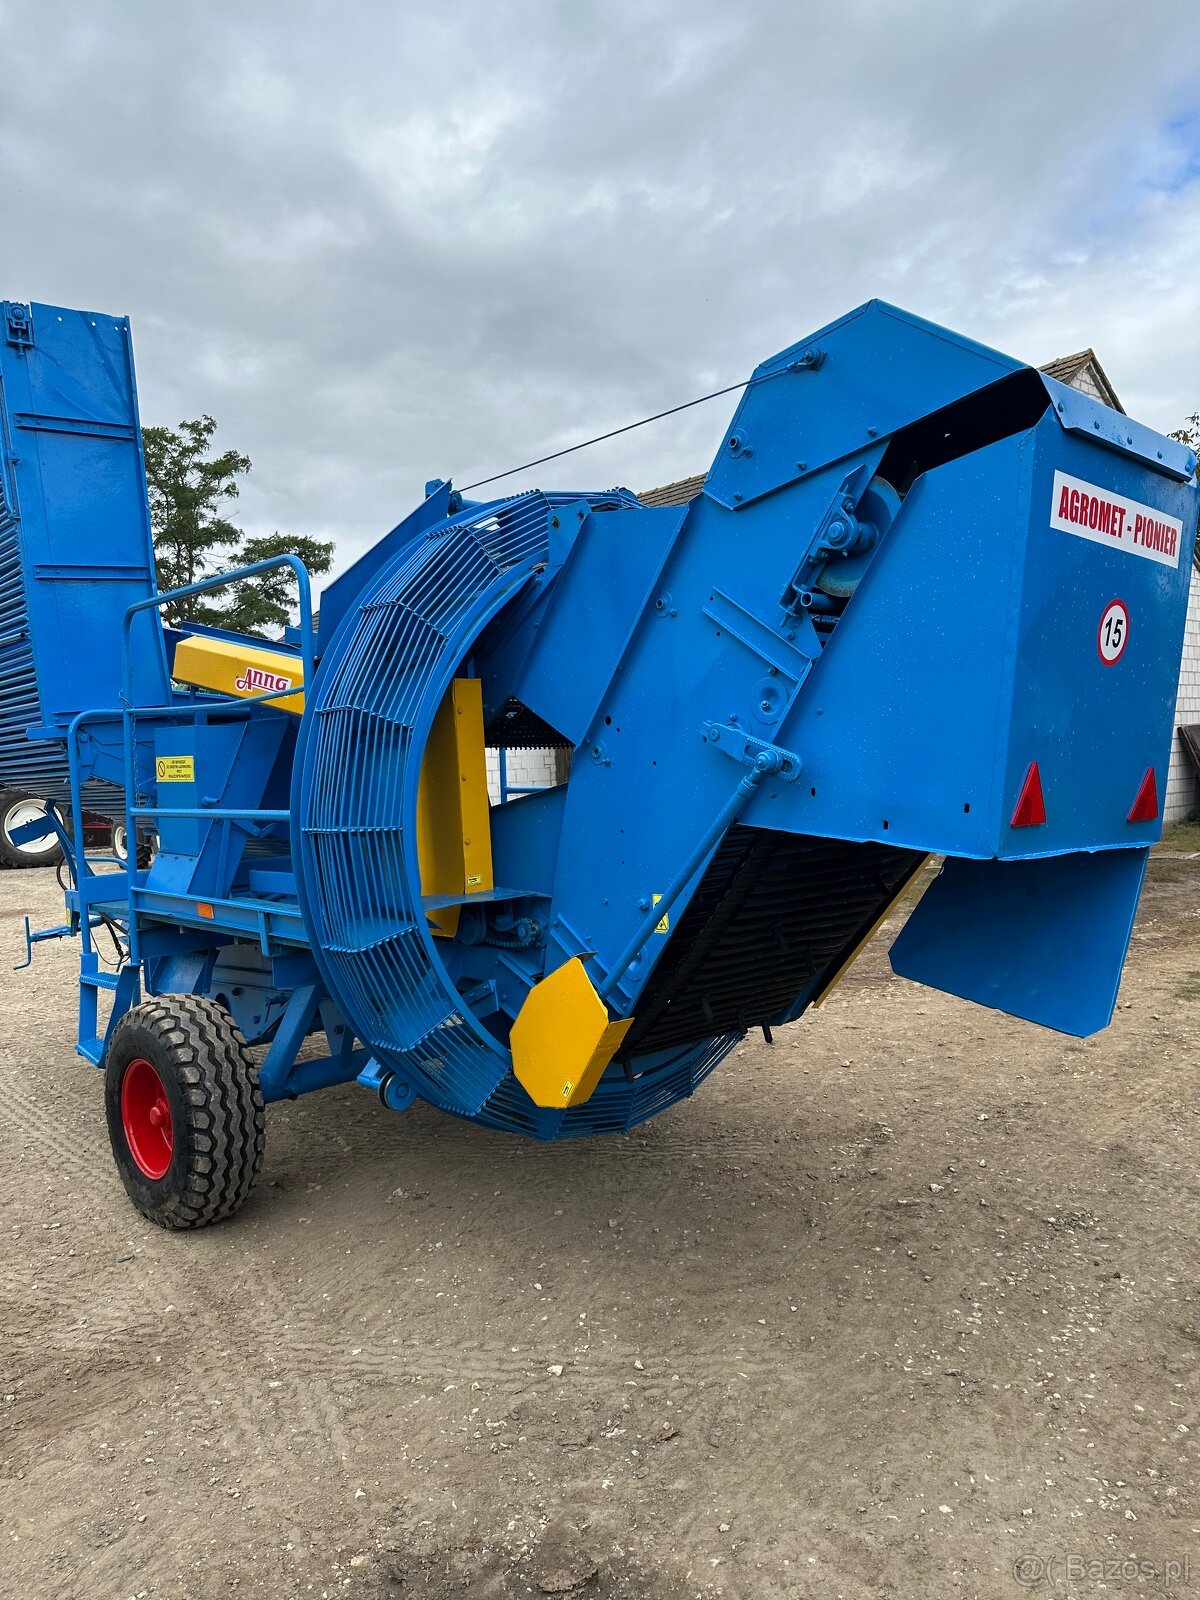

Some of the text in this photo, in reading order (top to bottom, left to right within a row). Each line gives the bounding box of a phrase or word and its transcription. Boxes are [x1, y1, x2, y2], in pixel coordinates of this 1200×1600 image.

[1058, 485, 1126, 538] AGROMET
[1133, 513, 1178, 557] PIONIER
[1105, 617, 1124, 648] 15
